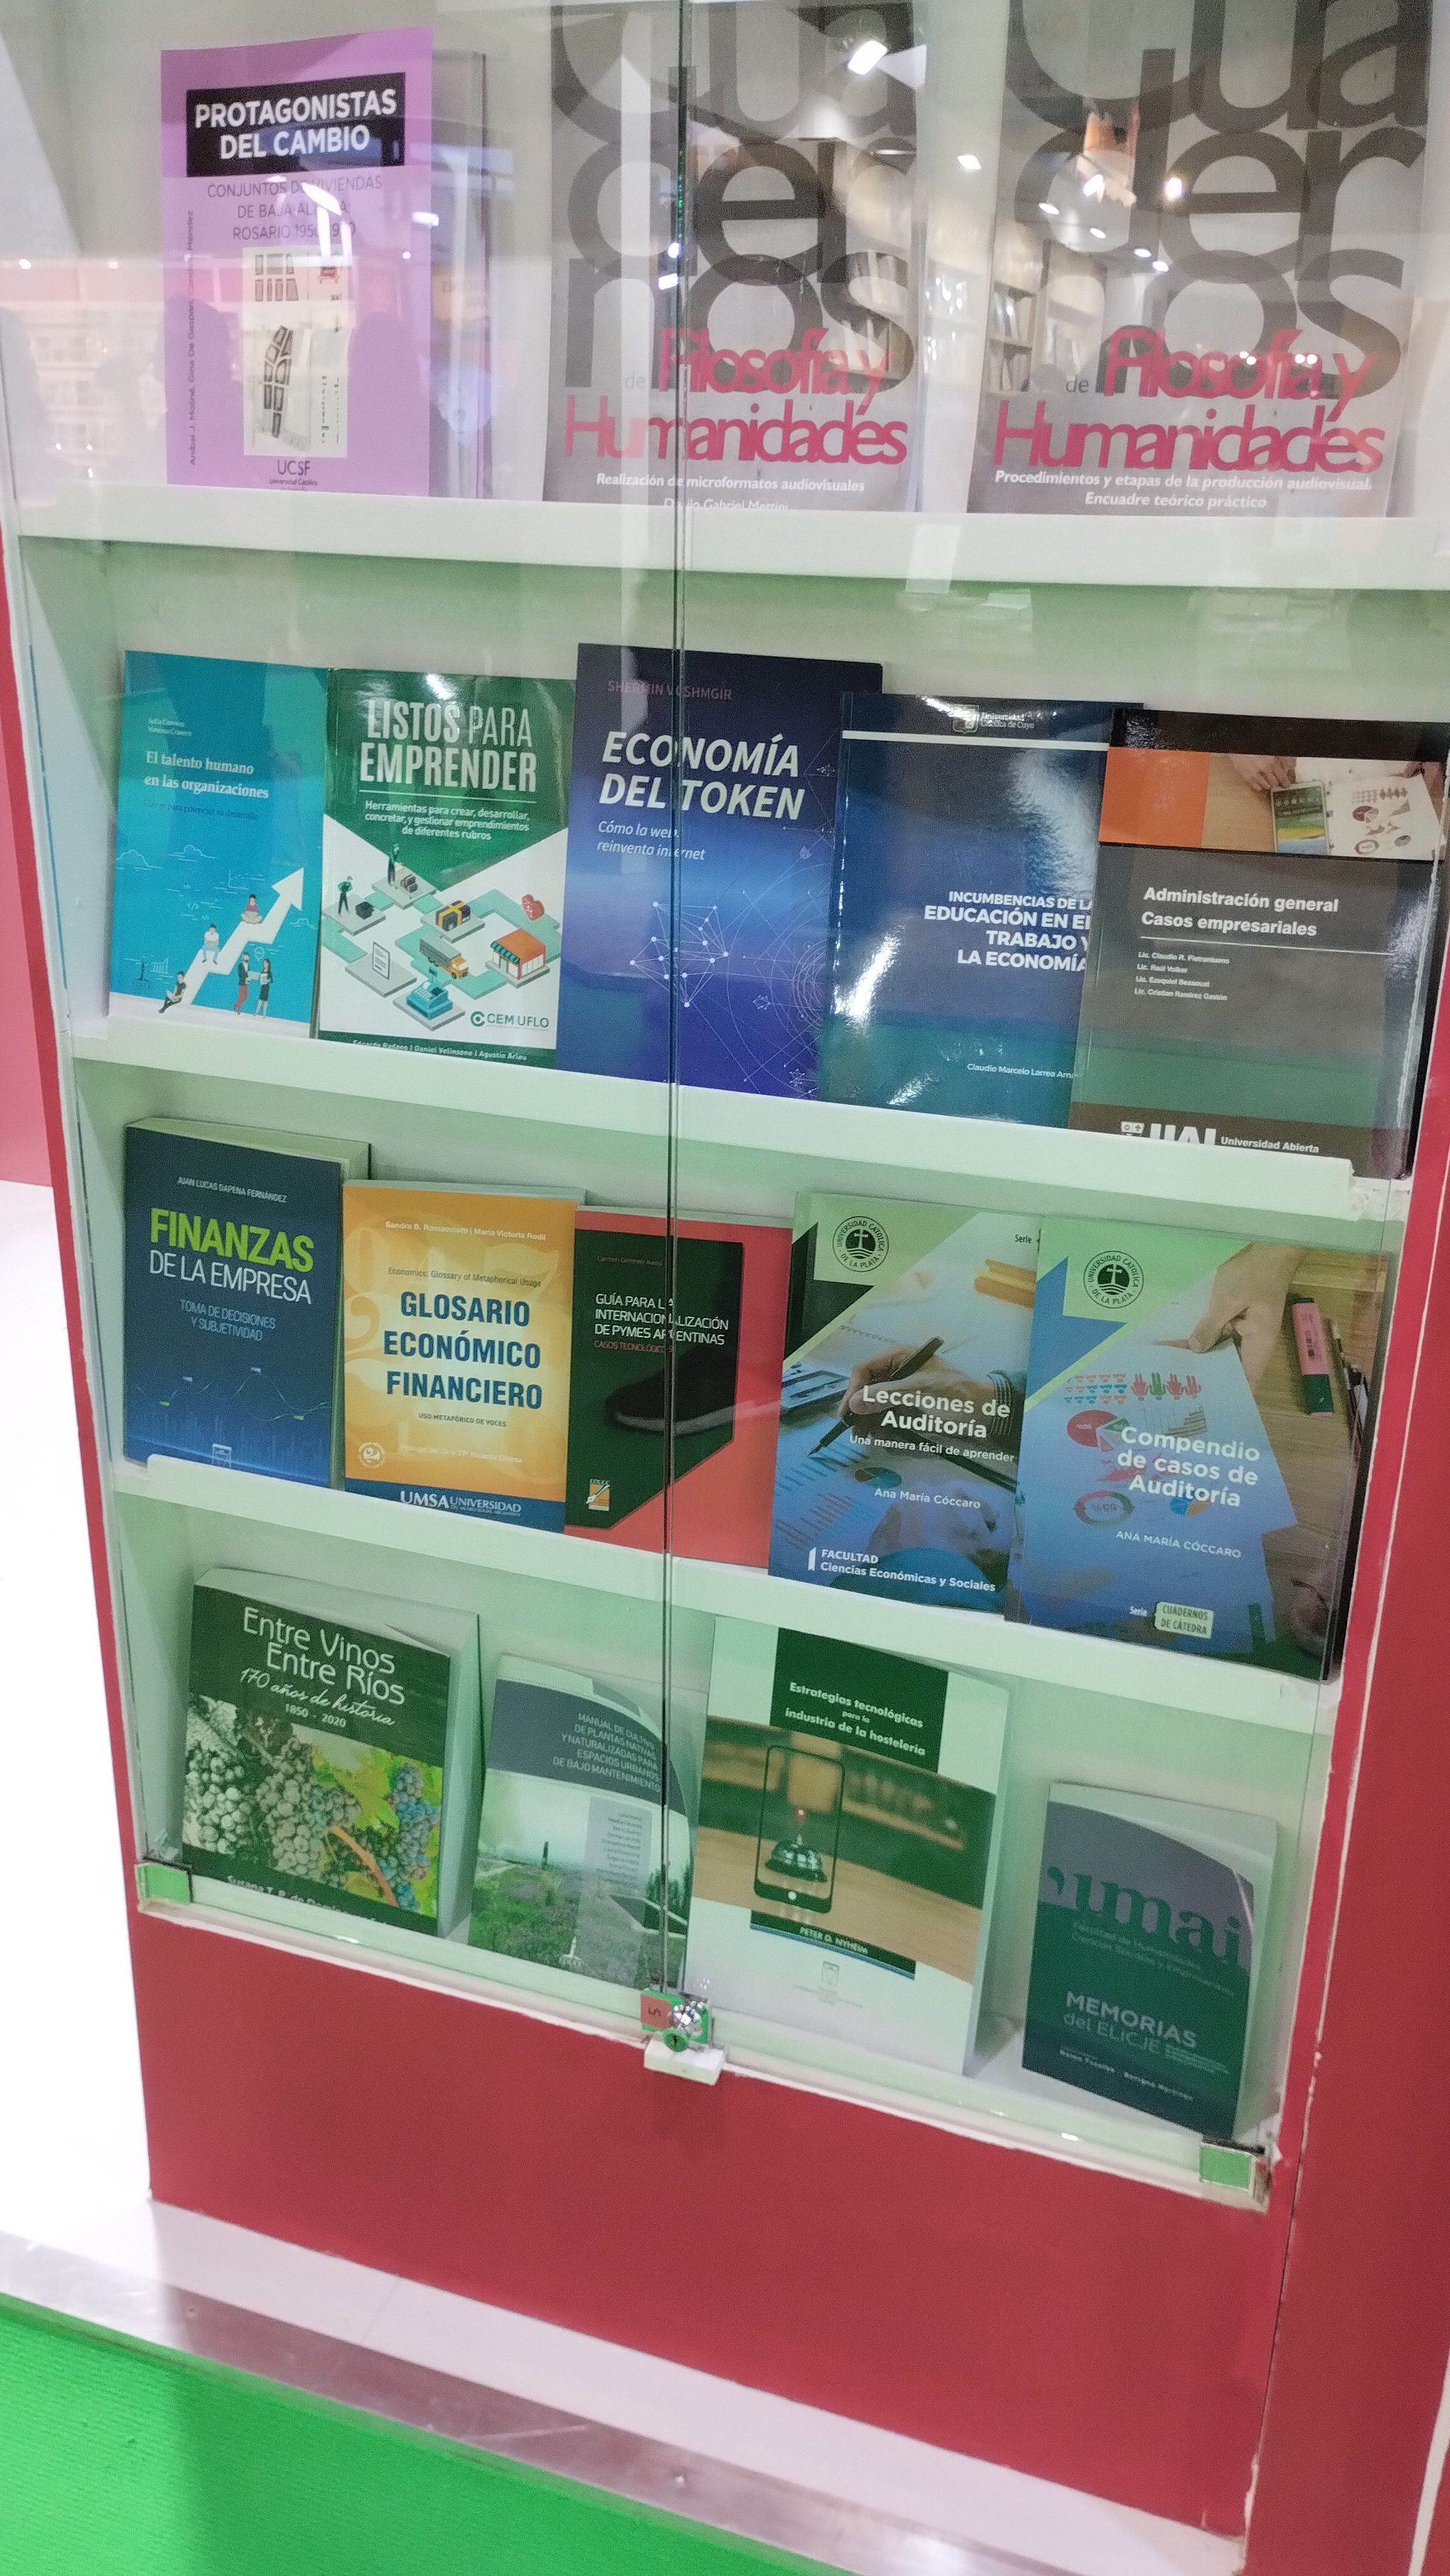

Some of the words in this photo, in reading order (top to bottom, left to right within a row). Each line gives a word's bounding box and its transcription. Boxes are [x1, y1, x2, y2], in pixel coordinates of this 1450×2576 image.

[195, 88, 397, 129] PROTAGONISTAS
[220, 133, 268, 160] DEL
[273, 124, 370, 157] CAMBIO
[1014, 49, 1427, 282] der
[207, 182, 287, 198] CONJUNTOS
[237, 205, 256, 218] DE
[259, 203, 292, 218] BAJA
[232, 225, 291, 241] ROSARIO
[625, 372, 646, 390] de
[858, 349, 894, 417] y
[1065, 377, 1089, 393] de
[1334, 352, 1377, 422] y
[565, 395, 908, 465] Humanidades
[993, 399, 1386, 474] Humanidades
[277, 460, 311, 476] UCSF
[995, 470, 1101, 486] Procedimientos
[1103, 475, 1113, 489] y
[1115, 475, 1161, 489] etapas
[1165, 473, 1182, 487] de
[1186, 474, 1199, 488] la
[1202, 474, 1283, 492] producción
[1287, 476, 1372, 491] audiovisual.
[596, 472, 664, 487] Realización
[686, 477, 779, 492] microformatos
[781, 478, 865, 492] audiovisuales
[1086, 491, 1152, 507] Encuadre
[1154, 492, 1205, 508] teórico
[1207, 493, 1267, 511] práctico
[367, 700, 460, 744] LISTOS
[469, 705, 533, 748] PARA
[146, 751, 158, 763] El
[161, 754, 202, 769] talento
[205, 757, 255, 775] humano
[359, 742, 537, 792] EMPRENDER
[602, 731, 799, 777] ECONOMÍA
[144, 776, 159, 786] en
[162, 774, 179, 789] las
[181, 780, 270, 799] organizaciones
[599, 773, 666, 809] DEL
[680, 779, 806, 820] TOKEN
[365, 800, 427, 814] Herramientas
[429, 805, 449, 816] para
[477, 810, 530, 821] desarrollar,
[402, 826, 413, 835] de
[414, 826, 460, 838] diferentes
[462, 830, 492, 840] rubros
[407, 817, 414, 826] y
[414, 816, 455, 827] gestionar
[454, 818, 530, 832] emprendimientos
[598, 820, 633, 836] Cómo
[635, 823, 648, 837] la
[597, 840, 655, 857] reinventa
[949, 891, 1055, 909] INCUMBENCIAS
[1057, 897, 1077, 910] DE
[1143, 886, 1270, 909] Administración
[1274, 896, 1339, 914] general
[924, 905, 1037, 927] EDUCACIÓN
[1041, 912, 1067, 929] EN
[1141, 910, 1194, 928] Casos
[1197, 917, 1318, 938] empresariales
[986, 929, 1076, 951] TRABAJO
[957, 949, 981, 965] LA
[985, 951, 1087, 972] ECONOMÍA
[487, 1012, 515, 1025] CEM
[517, 1014, 549, 1029] UFLO
[967, 1063, 997, 1073] Claudio
[998, 1065, 1029, 1076] Marcelo
[1031, 1068, 1056, 1078] Larrea
[1220, 1136, 1280, 1150] Universidad
[1282, 1140, 1319, 1154] Abierta
[151, 1207, 315, 1272] FINANZAS
[1014, 1234, 1033, 1244] Serie
[150, 1249, 177, 1277] DE
[181, 1255, 207, 1284] LA
[210, 1262, 312, 1305] EMPRESA
[431, 1270, 462, 1282] Glossary
[472, 1273, 518, 1285] Metaphorical
[519, 1277, 542, 1287] Usage
[180, 1299, 207, 1315] TOMA
[208, 1303, 220, 1316] DE
[221, 1306, 277, 1329] DECISIONES
[400, 1291, 530, 1327] GLOSARIO
[595, 1293, 623, 1306] GUÍA
[625, 1296, 656, 1309] PARA
[191, 1317, 197, 1327] Y
[198, 1318, 263, 1342] SUBJETIVIDAD
[594, 1323, 611, 1337] DE
[612, 1325, 651, 1340] PYMES
[595, 1309, 729, 1331] INTERNACIONLIZACIÓN
[383, 1330, 541, 1369] ECONÓMICO
[386, 1370, 542, 1410] FINANCIERO
[863, 1385, 974, 1414] Lecciones
[981, 1399, 1010, 1418] de
[418, 1412, 433, 1420] USO
[433, 1414, 474, 1424] METAFÓRICO
[486, 1419, 506, 1428] VOCES
[881, 1410, 988, 1439] Auditoría
[849, 1434, 872, 1446] Una
[874, 1437, 916, 1452] manera
[918, 1441, 943, 1454] fácil
[945, 1445, 961, 1456] de
[962, 1448, 1016, 1464] aprender
[1121, 1425, 1261, 1463] Compendio
[1117, 1450, 1147, 1470] de
[1154, 1457, 1221, 1481] casos
[1228, 1465, 1259, 1486] de
[400, 1490, 450, 1509] UMSA
[450, 1496, 522, 1513] UNIVERSIDAD
[874, 1488, 897, 1500] Ana
[899, 1490, 931, 1504] María
[933, 1495, 981, 1510] Cóccaro
[1128, 1473, 1242, 1508] Auditoría
[821, 1549, 879, 1565] FACULTAD
[1115, 1530, 1141, 1542] ANA
[1144, 1533, 1181, 1549] MARÍA
[1183, 1539, 1242, 1559] CÓCCARO
[820, 1561, 868, 1577] Ciencias
[869, 1566, 938, 1585] Económicas
[939, 1577, 947, 1587] y
[949, 1577, 997, 1593] Sociales
[1129, 1605, 1148, 1618] Serie
[1161, 1604, 1209, 1622] CUADERNOS
[1161, 1618, 1172, 1630] DE
[1173, 1617, 1208, 1637] CÁTEDRA
[243, 1606, 311, 1652] Entre
[320, 1628, 396, 1675] Vinos
[267, 1641, 336, 1686] Entre
[346, 1664, 406, 1706] Ríos
[239, 1667, 271, 1690] 170
[270, 1682, 309, 1702] años
[309, 1687, 332, 1706] de
[332, 1692, 396, 1726] historia
[789, 1682, 853, 1707] Estrategias
[854, 1699, 924, 1729] tecnológicas
[285, 1703, 309, 1718] 1850
[321, 1713, 347, 1729] 2020
[841, 1710, 861, 1721] para
[861, 1715, 871, 1724] la
[784, 1707, 836, 1729] industria
[837, 1721, 853, 1734] de
[854, 1725, 867, 1738] la
[868, 1729, 926, 1757] hostelería
[1065, 1990, 1197, 2049] MEMORIAS
[1064, 2013, 1092, 2032] del
[1096, 2024, 1161, 2056] ELICJE
